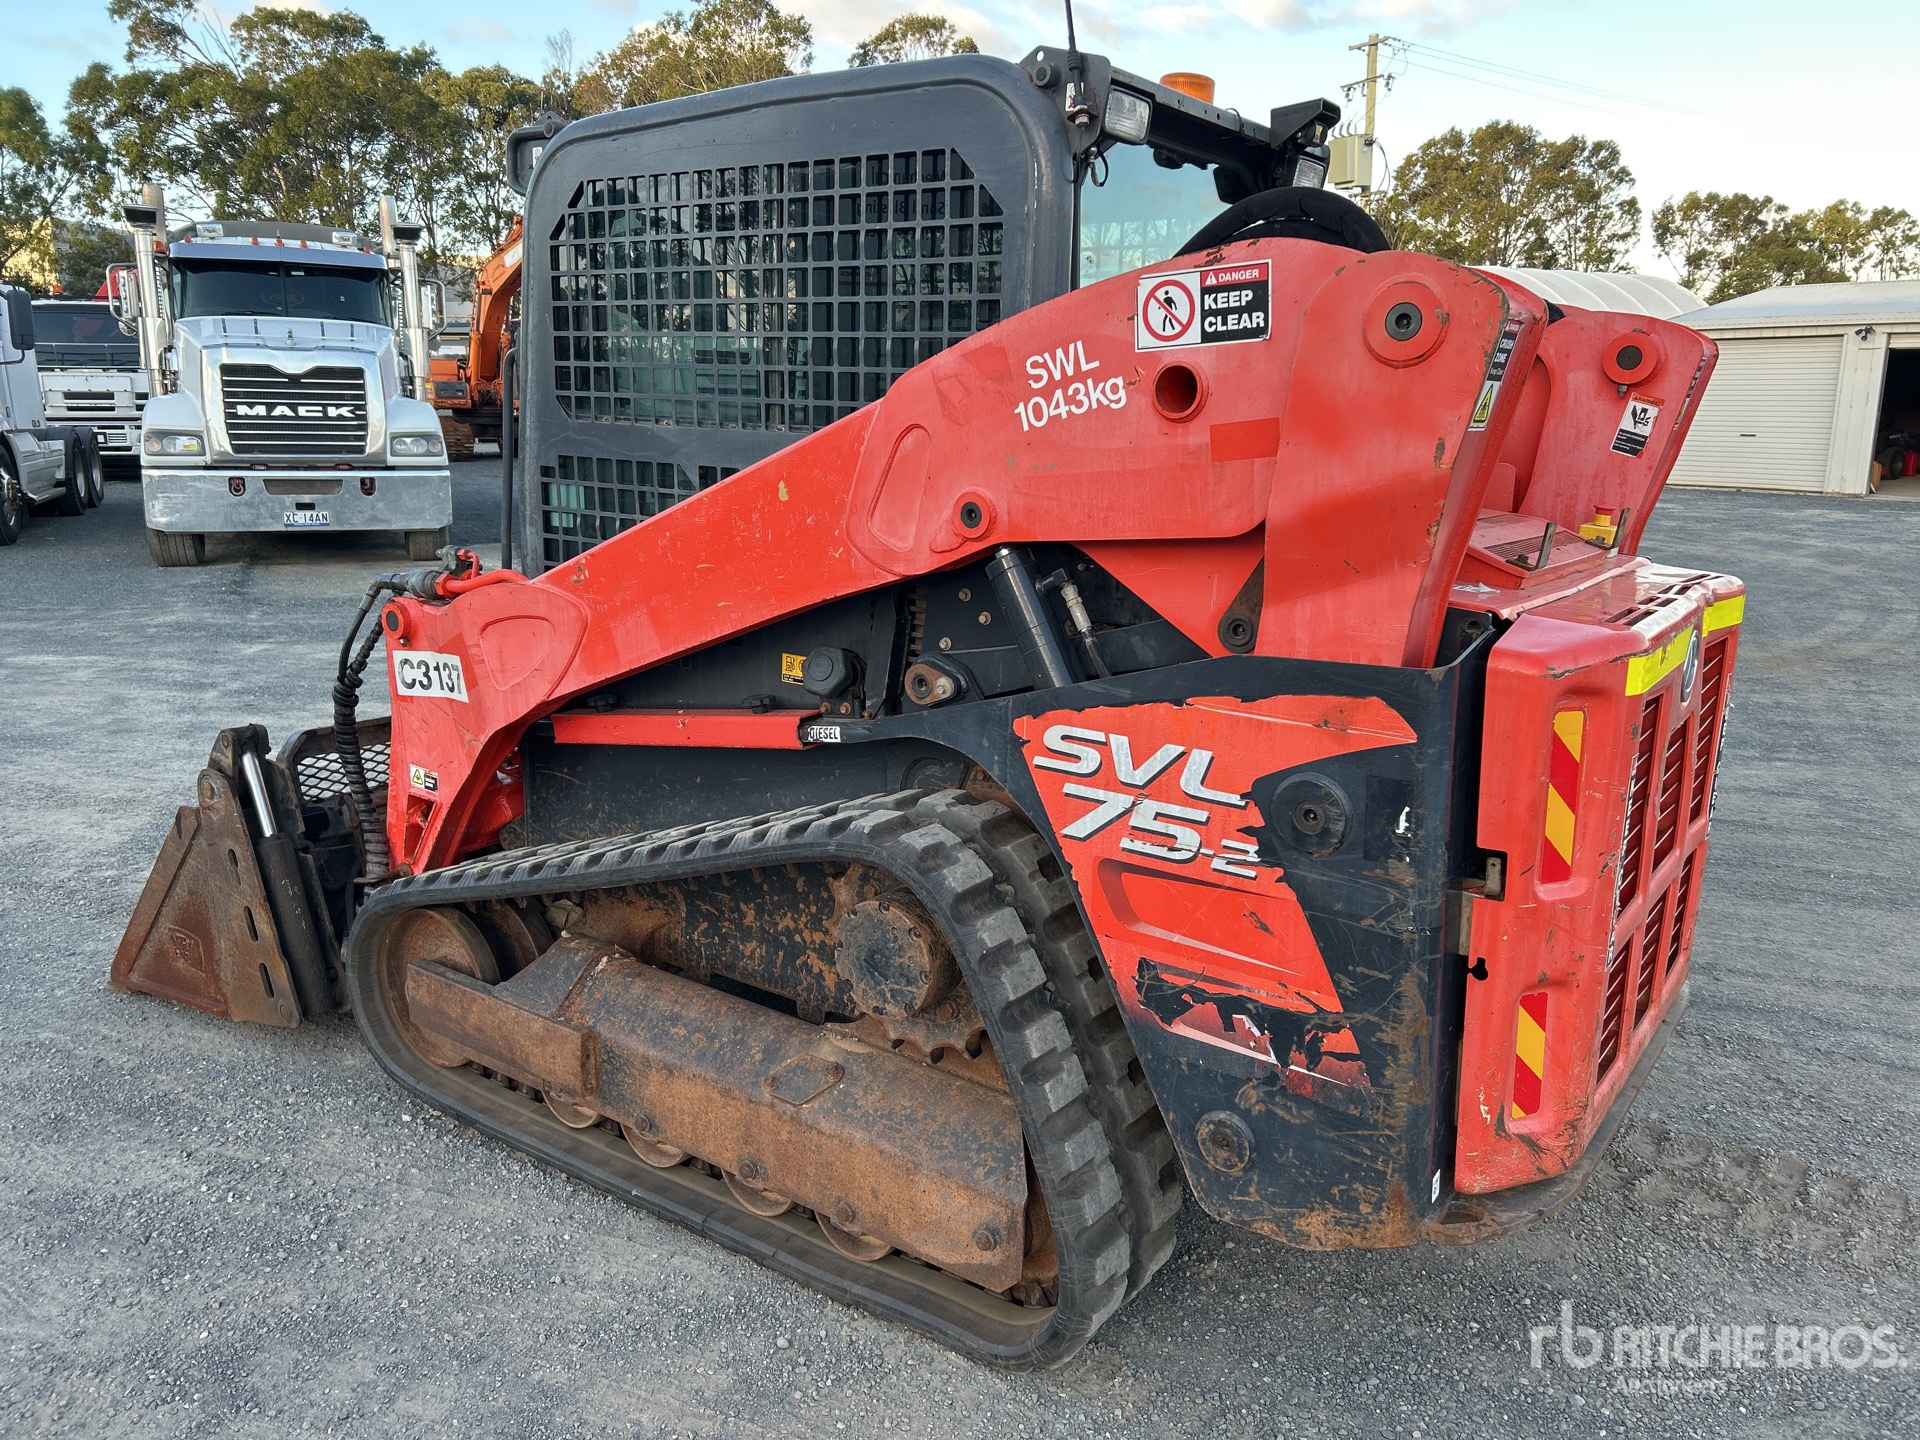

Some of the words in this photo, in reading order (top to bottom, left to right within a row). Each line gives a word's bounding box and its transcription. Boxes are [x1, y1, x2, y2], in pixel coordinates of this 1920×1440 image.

[1218, 268, 1259, 283] DANGER
[1203, 289, 1254, 311] KEEP
[1203, 311, 1265, 333] CLEAR
[1025, 340, 1100, 389] SWL
[236, 405, 355, 417] MACK
[1014, 375, 1127, 432] 1043kg
[398, 658, 462, 695] C3137
[808, 727, 839, 740] DIESEL
[1032, 725, 1247, 808] SVL
